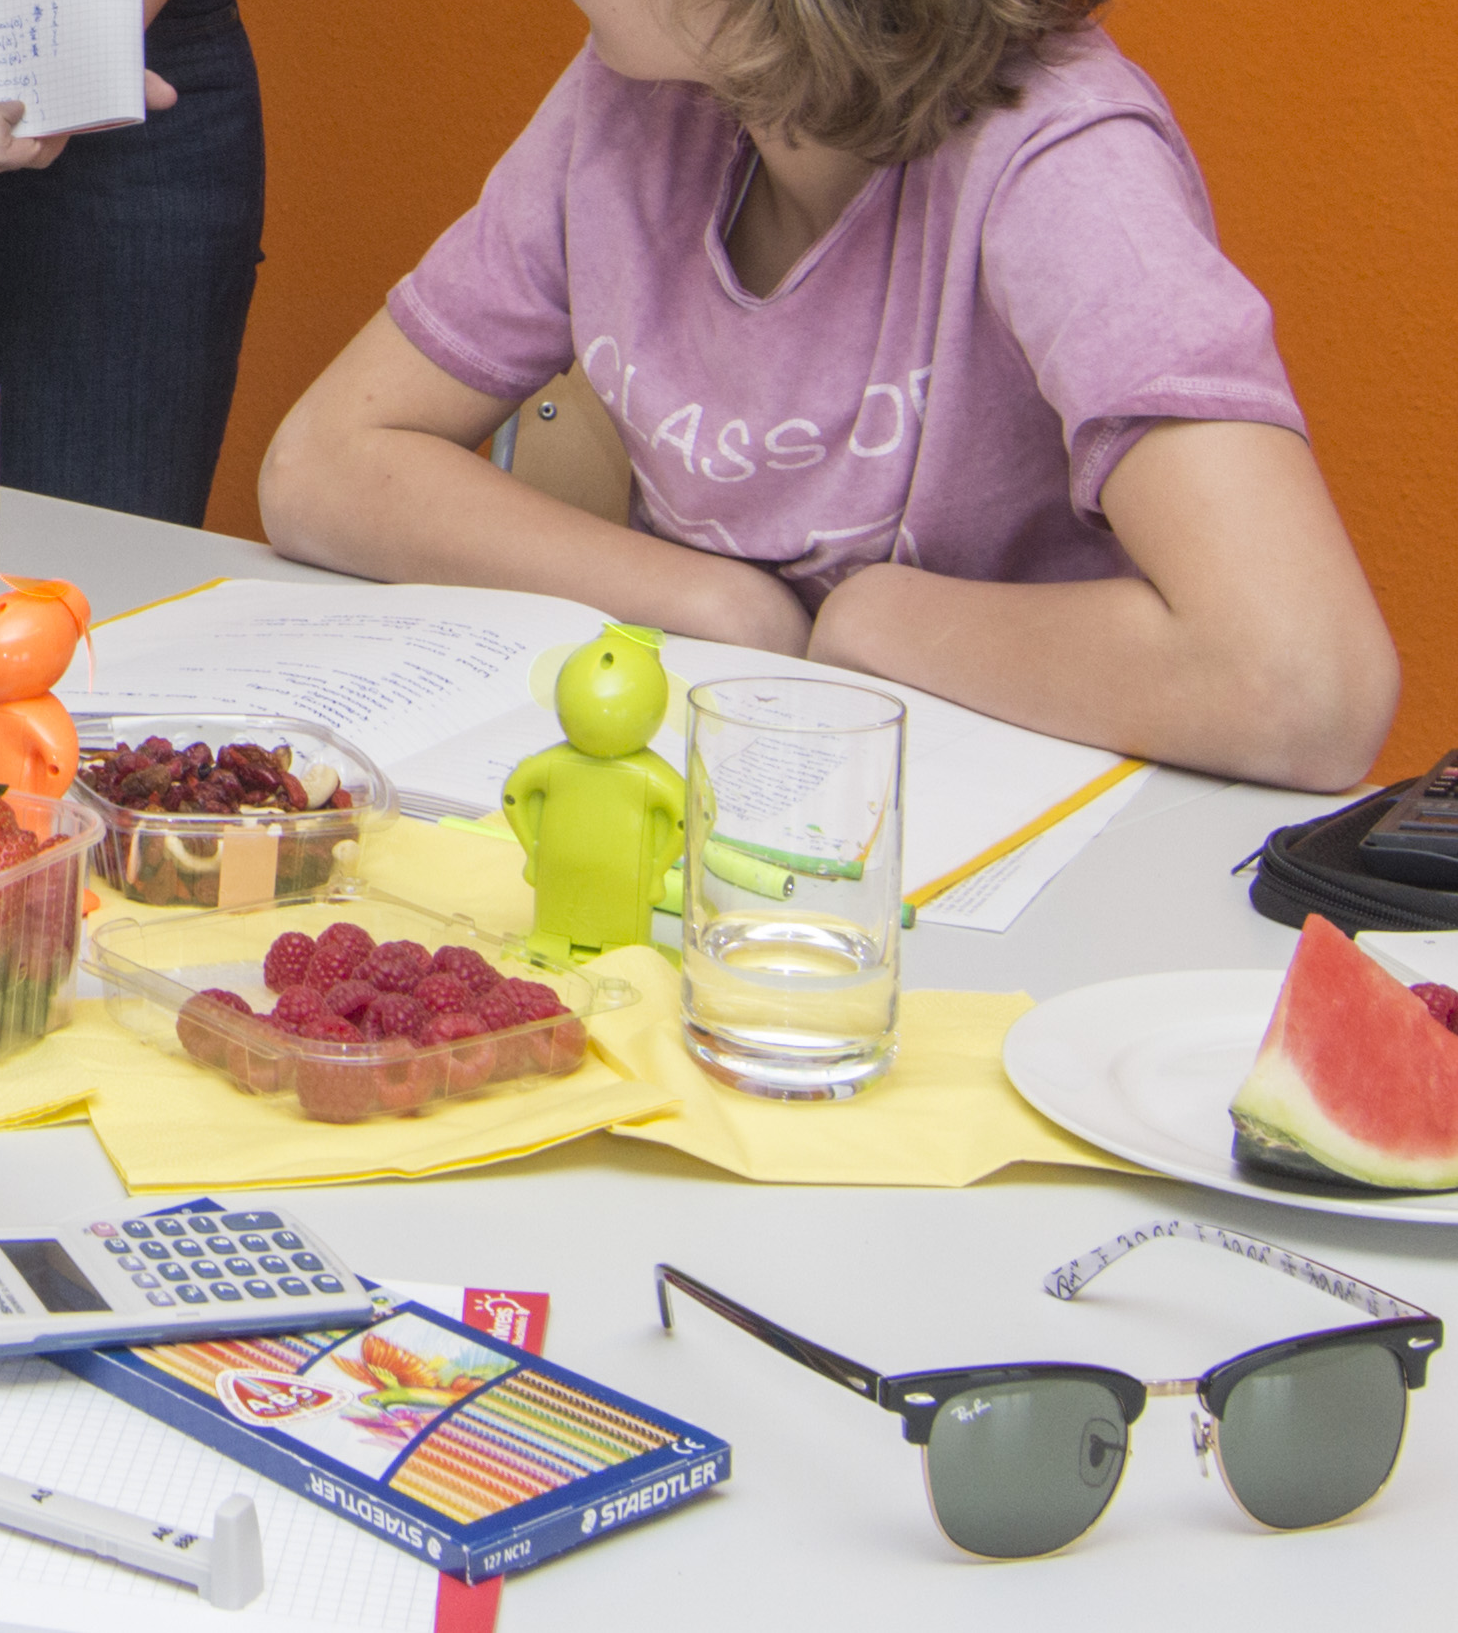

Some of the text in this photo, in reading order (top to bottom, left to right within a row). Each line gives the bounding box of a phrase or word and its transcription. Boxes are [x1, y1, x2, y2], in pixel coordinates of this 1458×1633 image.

[308, 1471, 425, 1550] STAEDTLER
[601, 1459, 717, 1527] STAEDTLER
[483, 1540, 532, 1572] 127 NC12
